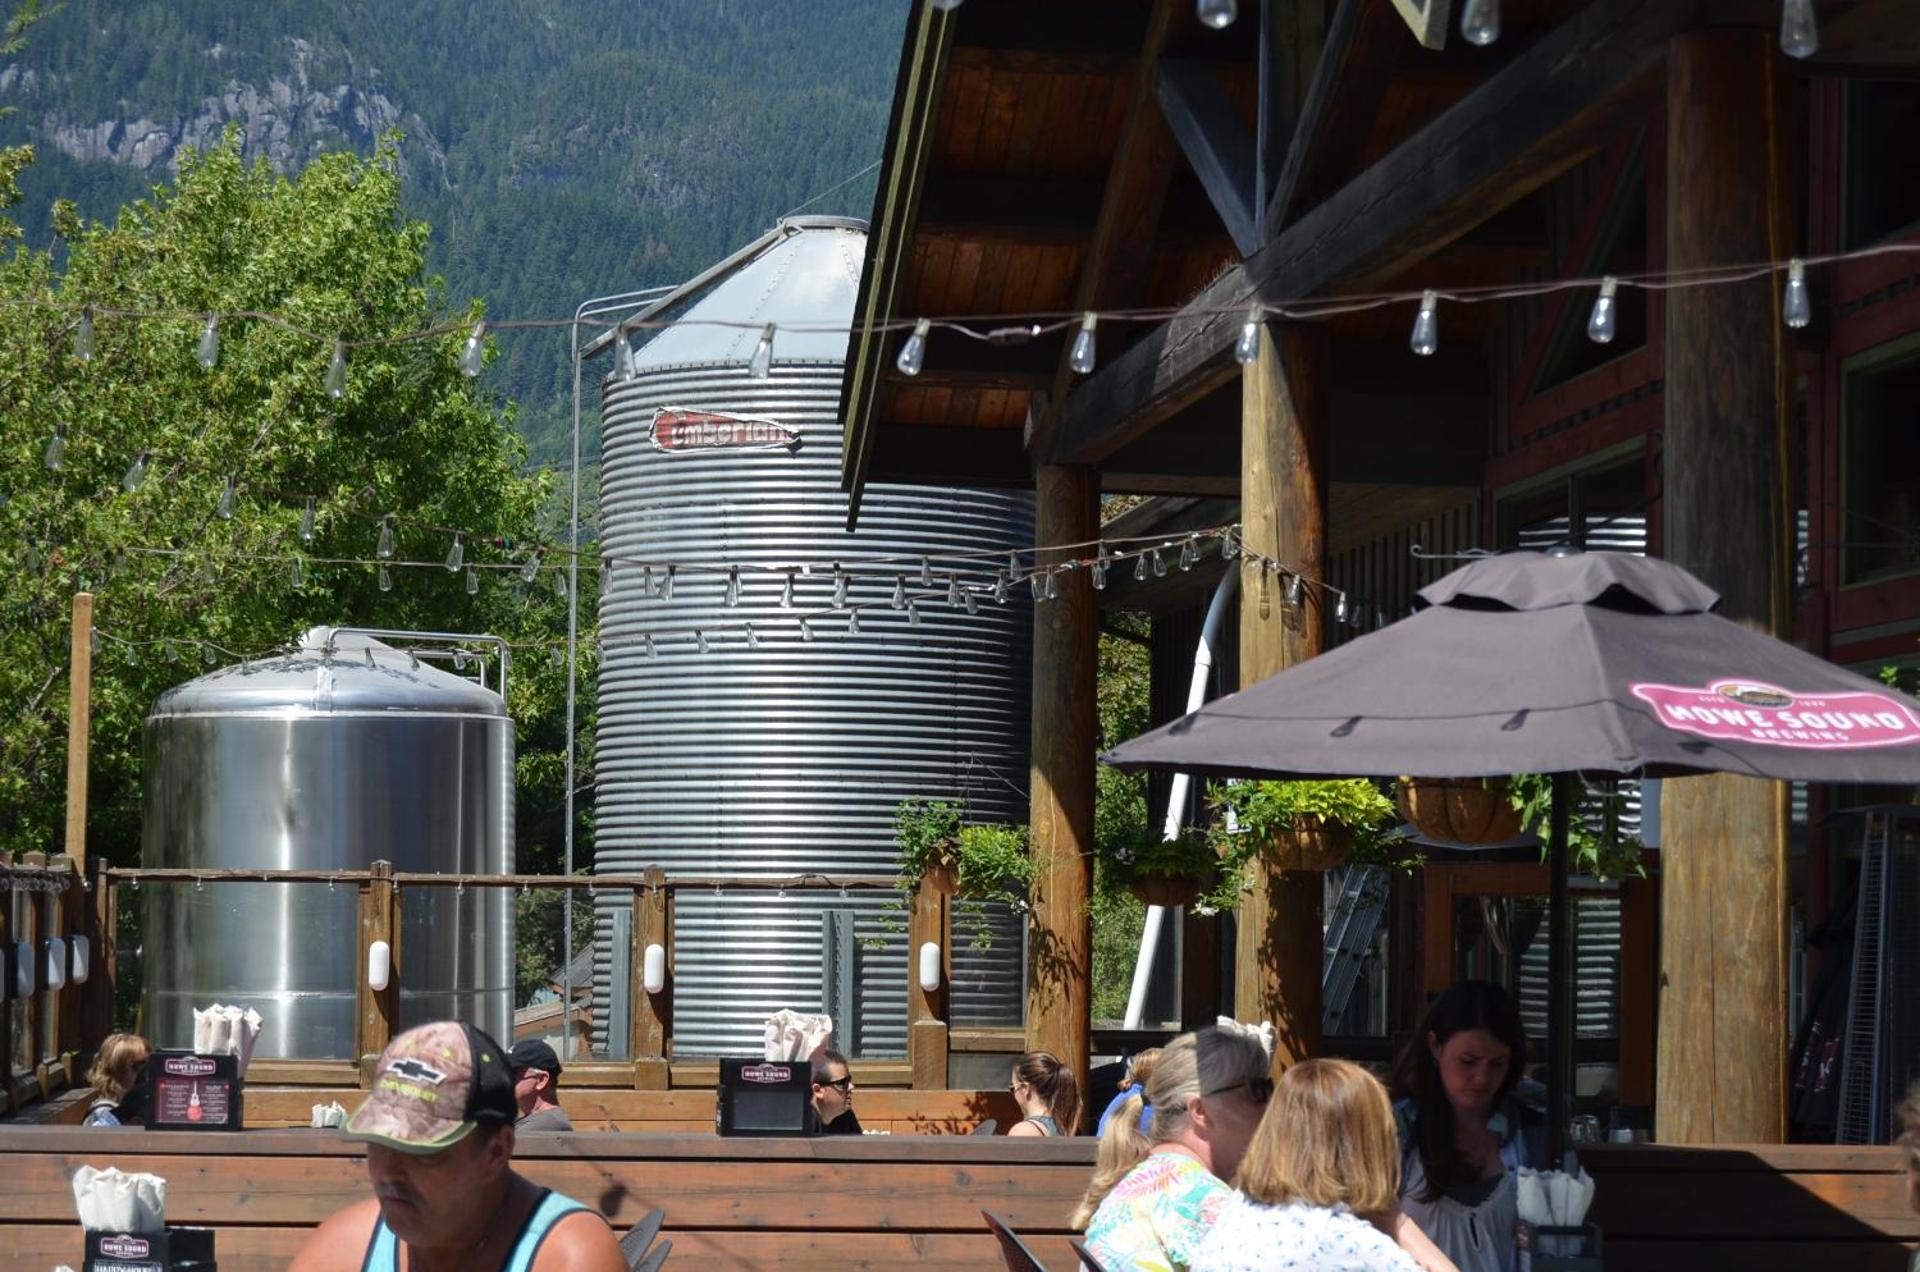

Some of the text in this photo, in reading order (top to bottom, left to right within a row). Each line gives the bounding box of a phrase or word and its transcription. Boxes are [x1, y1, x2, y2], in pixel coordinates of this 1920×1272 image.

[1665, 703, 1905, 730] HOWE SOUND
[1751, 728, 1849, 742] BREWING
